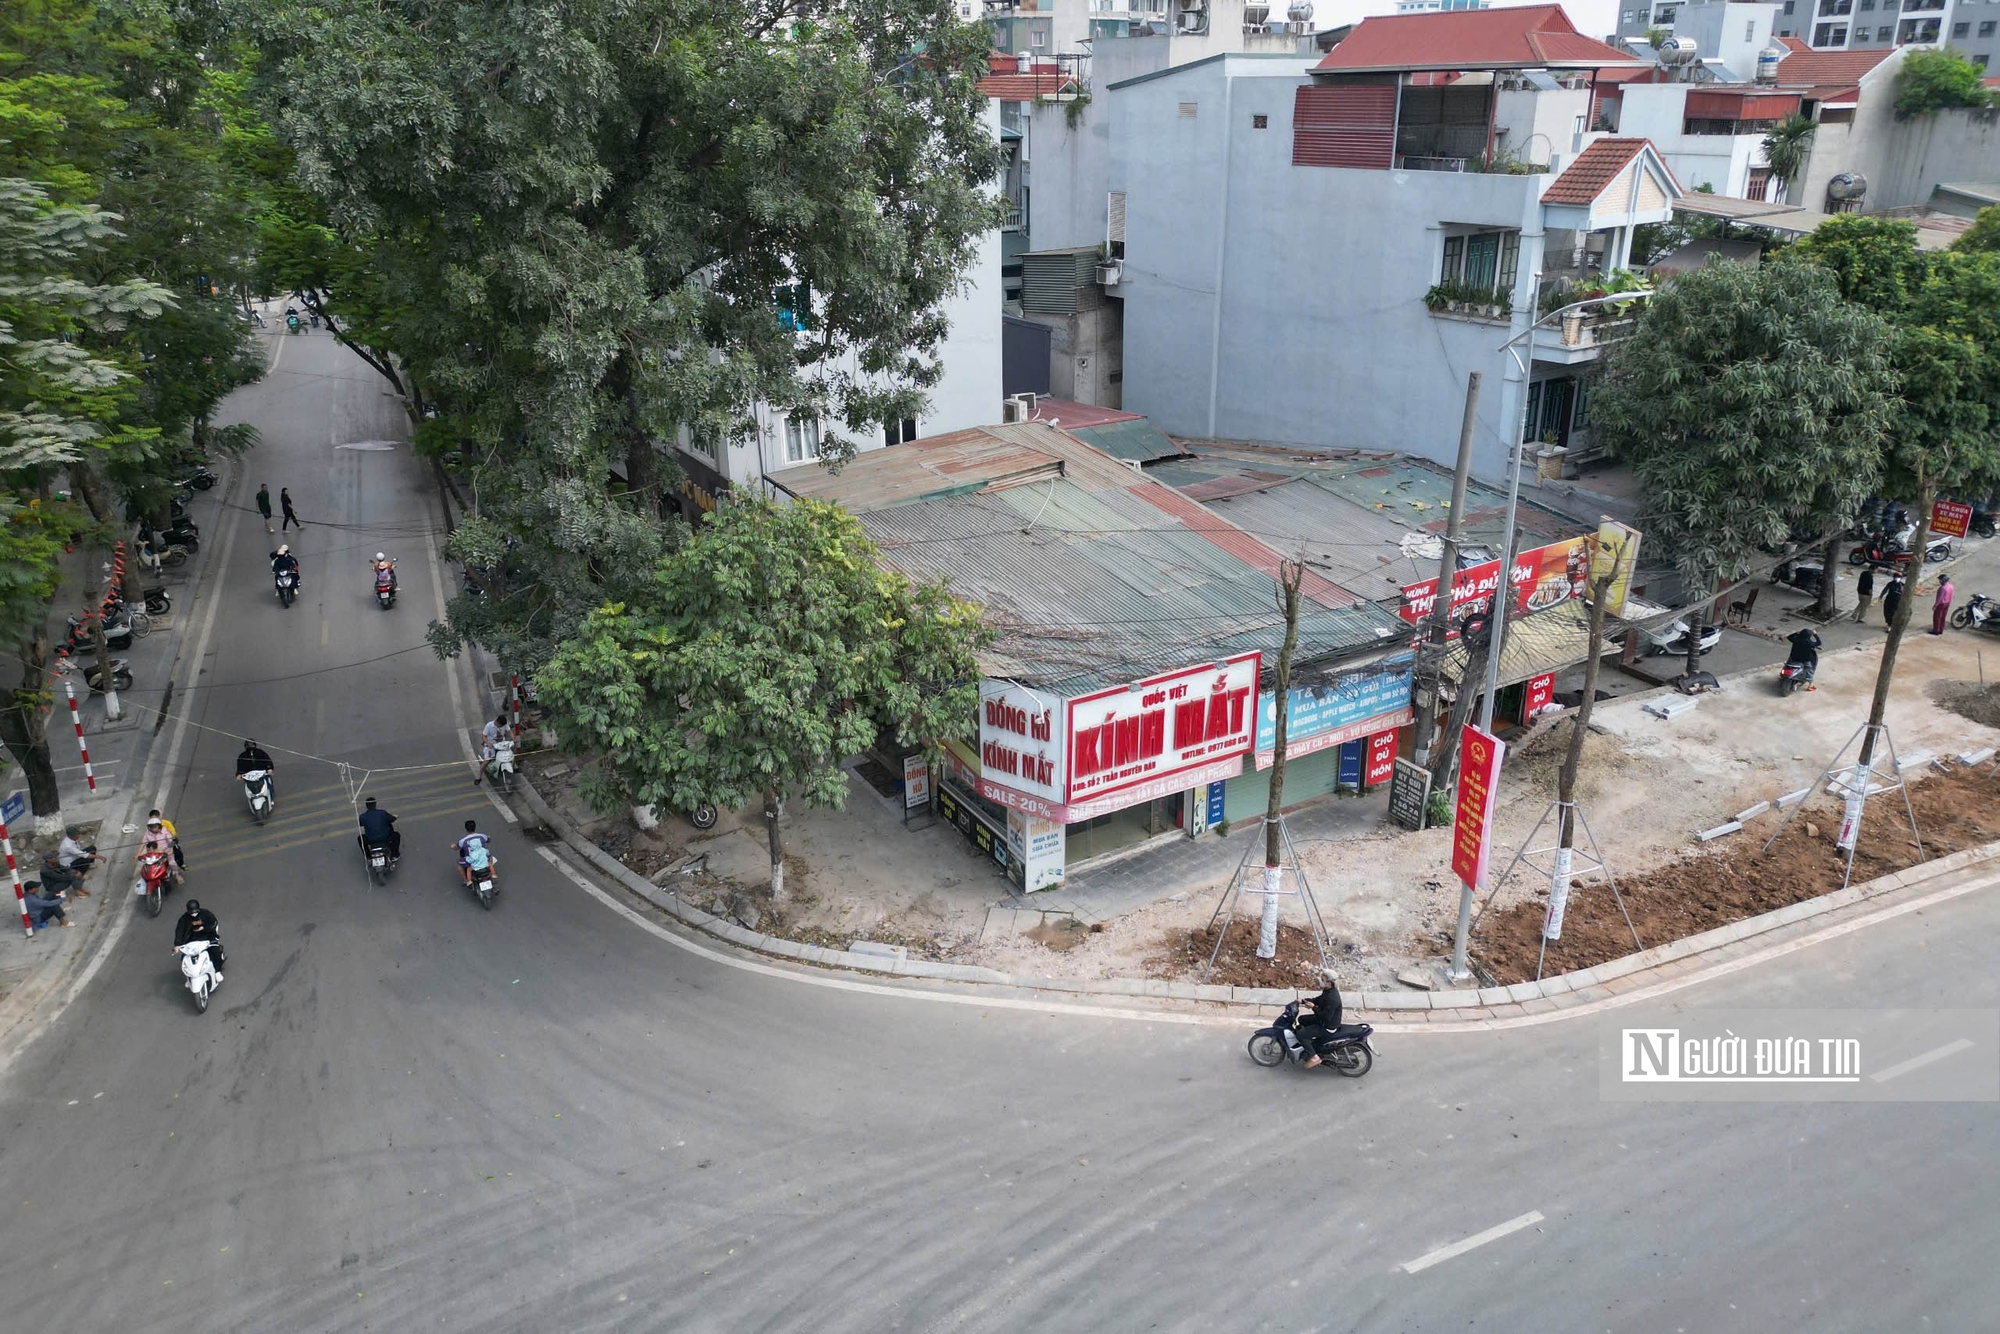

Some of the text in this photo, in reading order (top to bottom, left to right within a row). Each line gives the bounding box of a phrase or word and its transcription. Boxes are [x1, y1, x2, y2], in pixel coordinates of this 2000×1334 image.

[1406, 585, 1430, 599] HÙNG
[1533, 675, 1550, 690] CHÓ
[1142, 684, 1188, 708] QUỐC VIỆT
[1295, 702, 1316, 714] MUA
[1319, 694, 1339, 707] BÁN
[1534, 691, 1546, 704] ĐỦ
[986, 695, 1027, 736] ĐỒNG
[1529, 705, 1542, 718] MÓ
[1075, 674, 1250, 778] KÍNH MẮT
[1374, 731, 1394, 748] CHÓ
[1376, 747, 1390, 762] ĐỦ
[983, 741, 1054, 787] KÍNH MẮT
[1371, 763, 1391, 779] MÓN
[906, 765, 927, 781] ĐỒNG
[912, 780, 923, 794] HỒ
[983, 785, 1051, 817] SALE 20%
